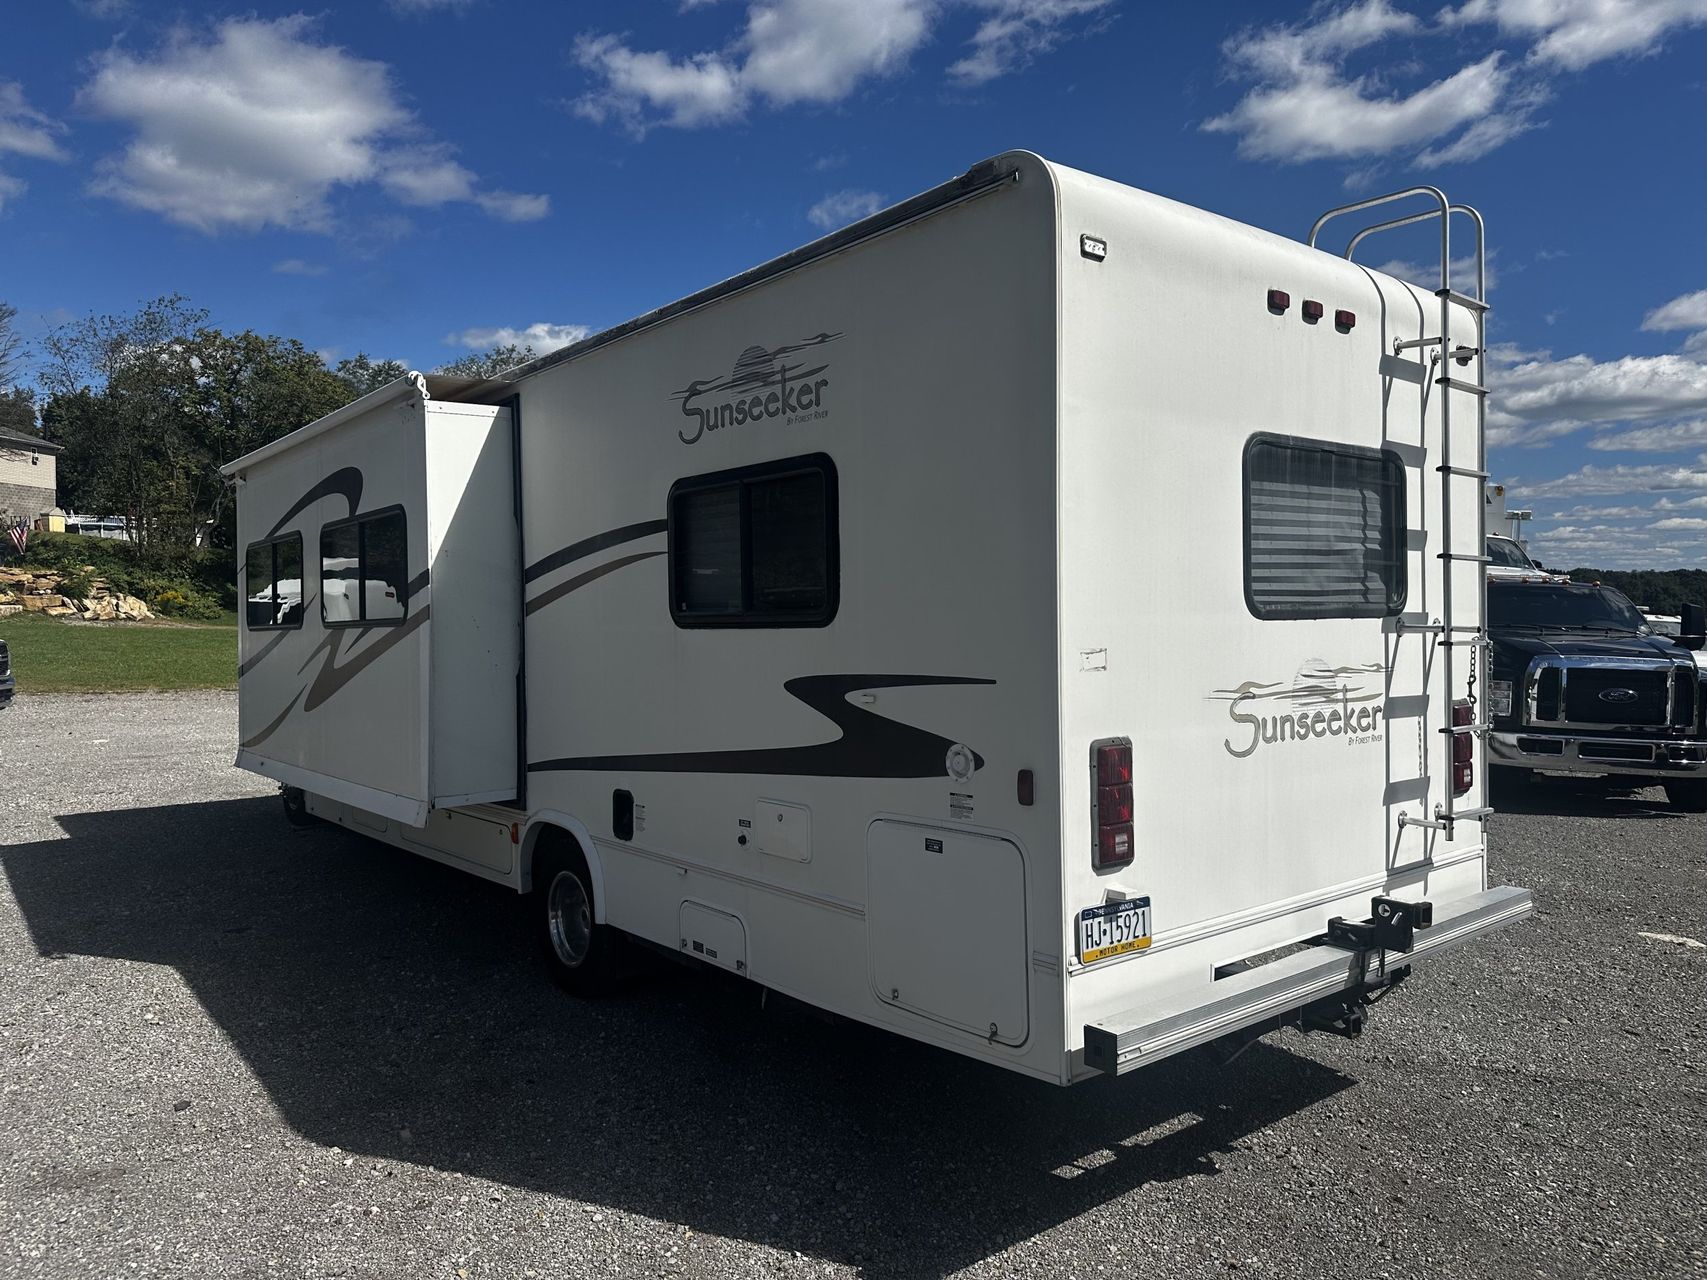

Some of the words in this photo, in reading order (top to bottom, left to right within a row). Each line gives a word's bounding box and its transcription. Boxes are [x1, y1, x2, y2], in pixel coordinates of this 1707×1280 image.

[678, 364, 829, 445] Sunseeker
[794, 413, 813, 425] FOREST
[1224, 684, 1382, 759] Sunseeker
[1355, 735, 1371, 745] FOREST
[1099, 945, 1118, 956] MOTOR
[1120, 940, 1136, 951] HOME
